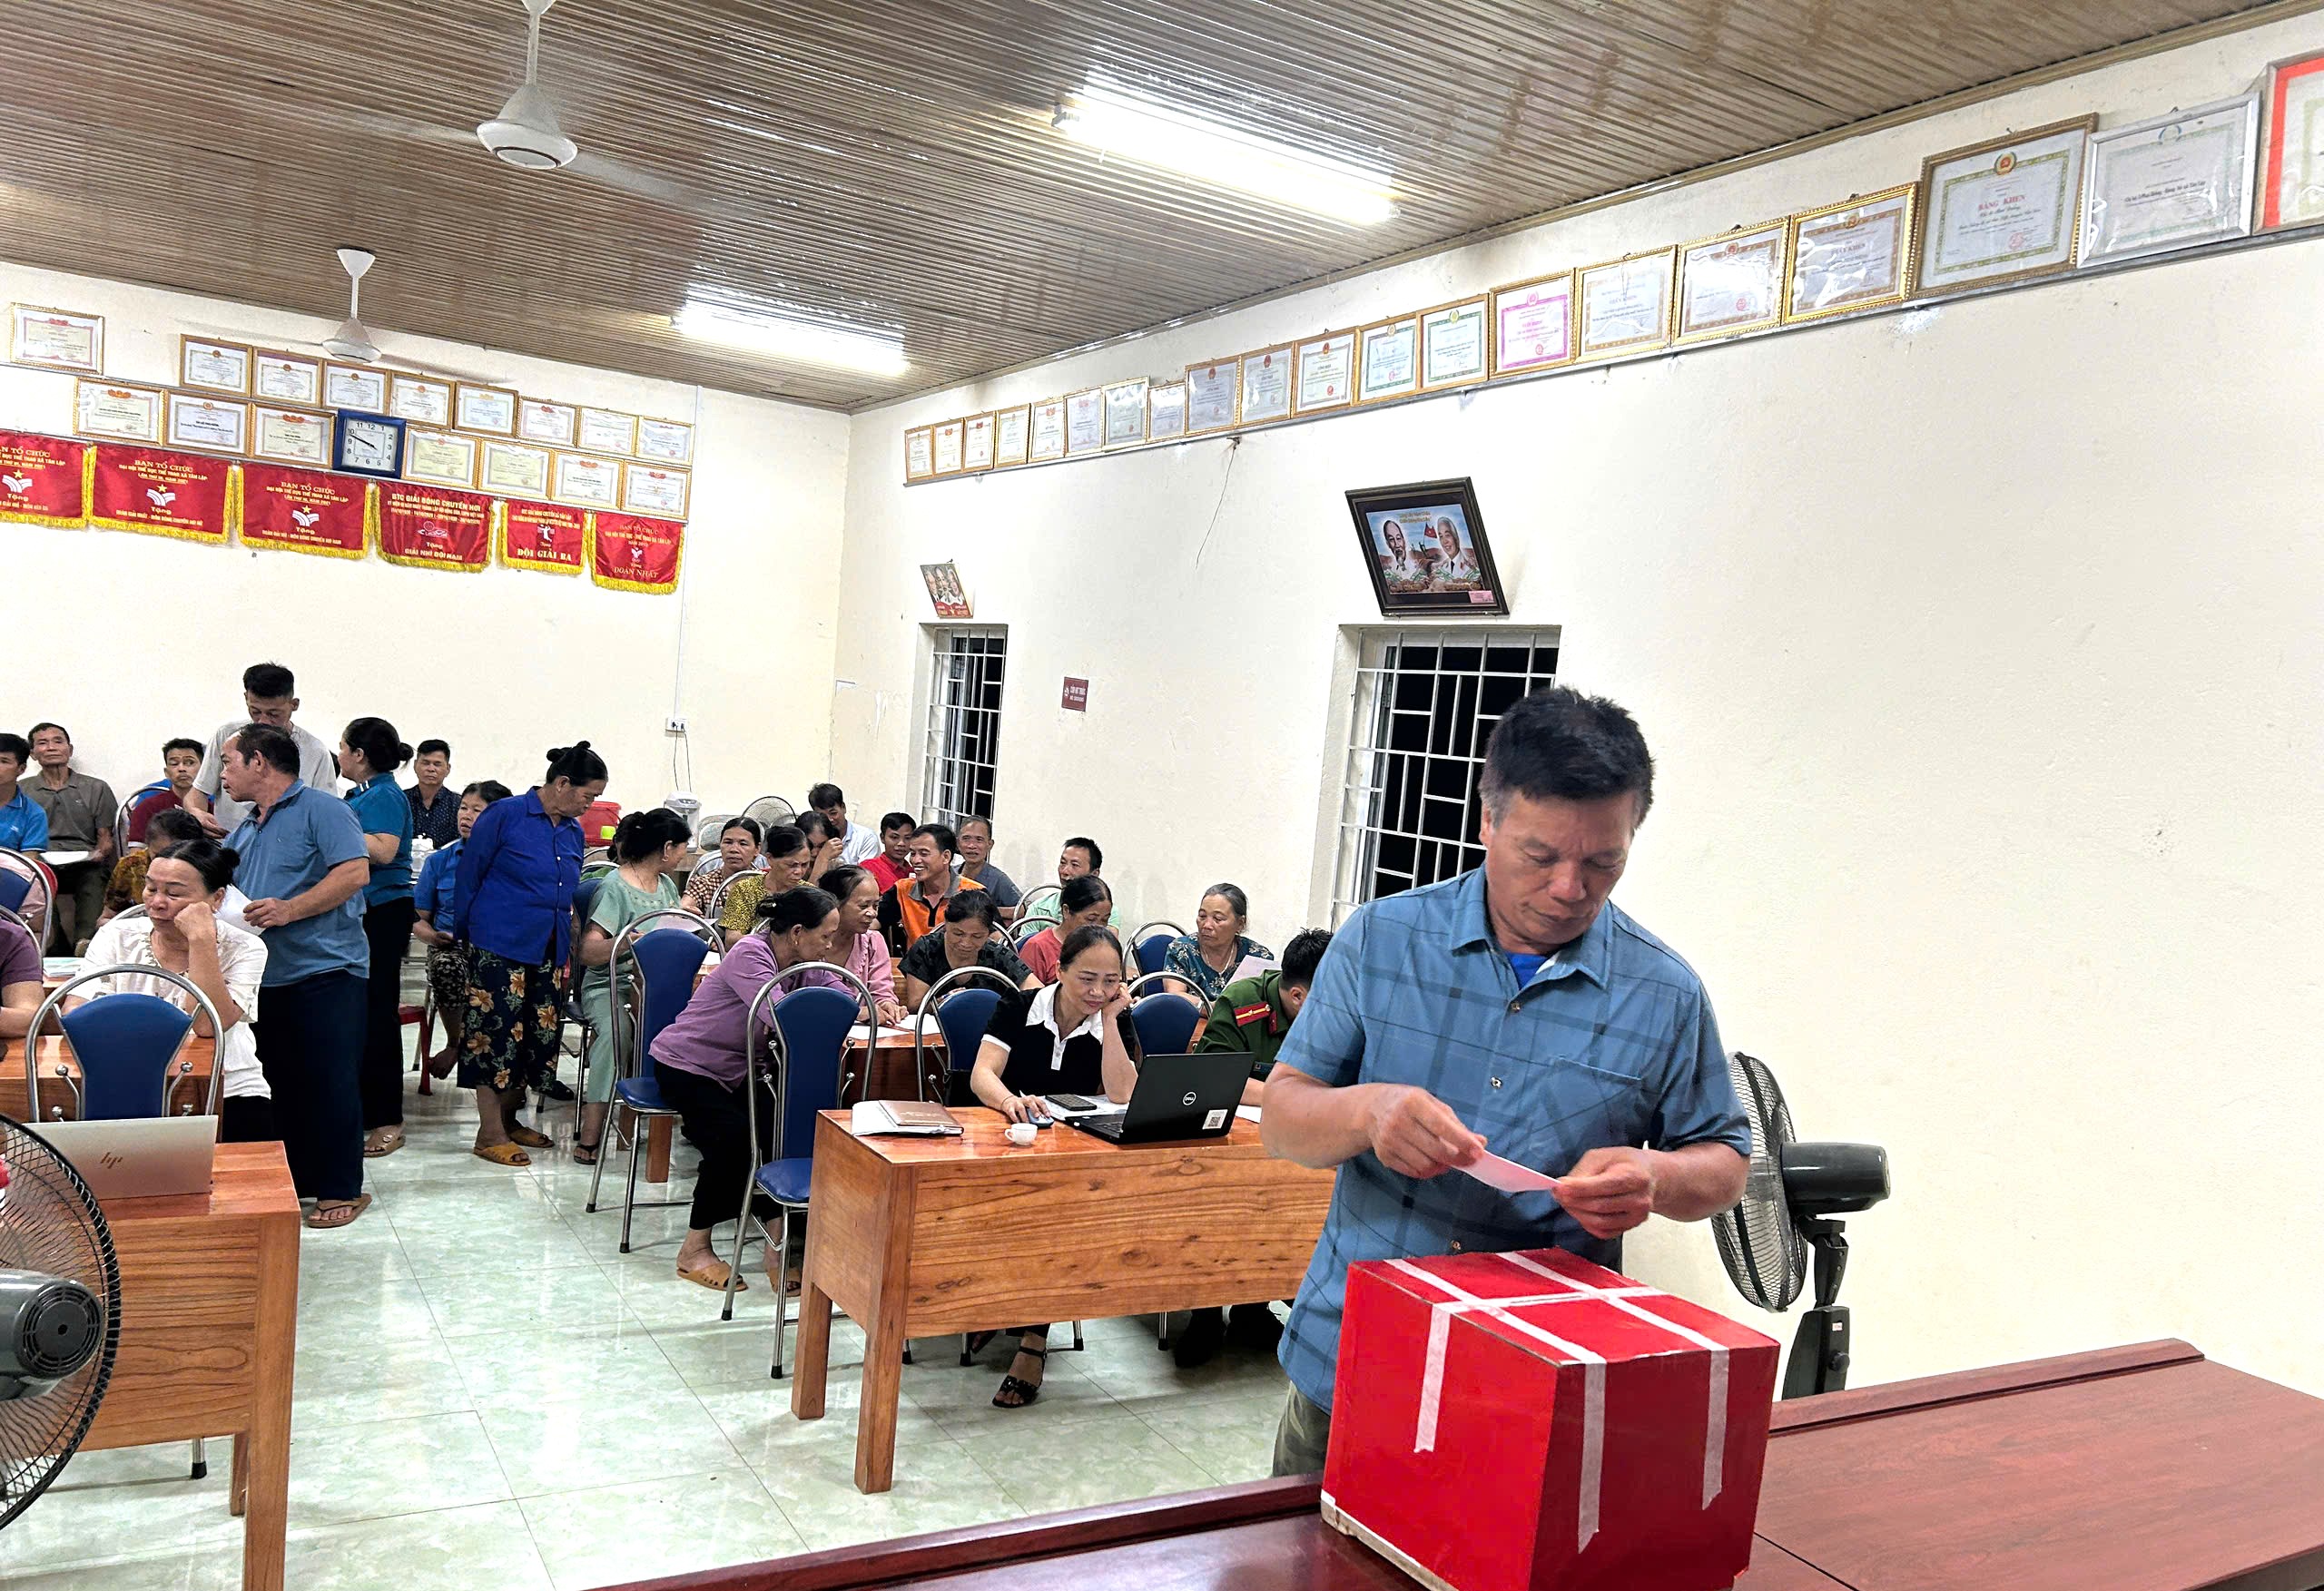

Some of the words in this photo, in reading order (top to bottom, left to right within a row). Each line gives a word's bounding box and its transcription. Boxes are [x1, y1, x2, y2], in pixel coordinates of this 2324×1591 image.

[2004, 195, 2025, 204] KHEN
[11, 446, 24, 455] TỔ
[155, 461, 167, 469] TỔ
[170, 465, 192, 473] CHỨC
[313, 486, 335, 495] CHỨC
[406, 494, 419, 503] GIẢI
[469, 504, 480, 512] HƠI
[517, 547, 534, 558] ĐỘI
[537, 548, 556, 558] GIẢI
[560, 553, 571, 561] BA
